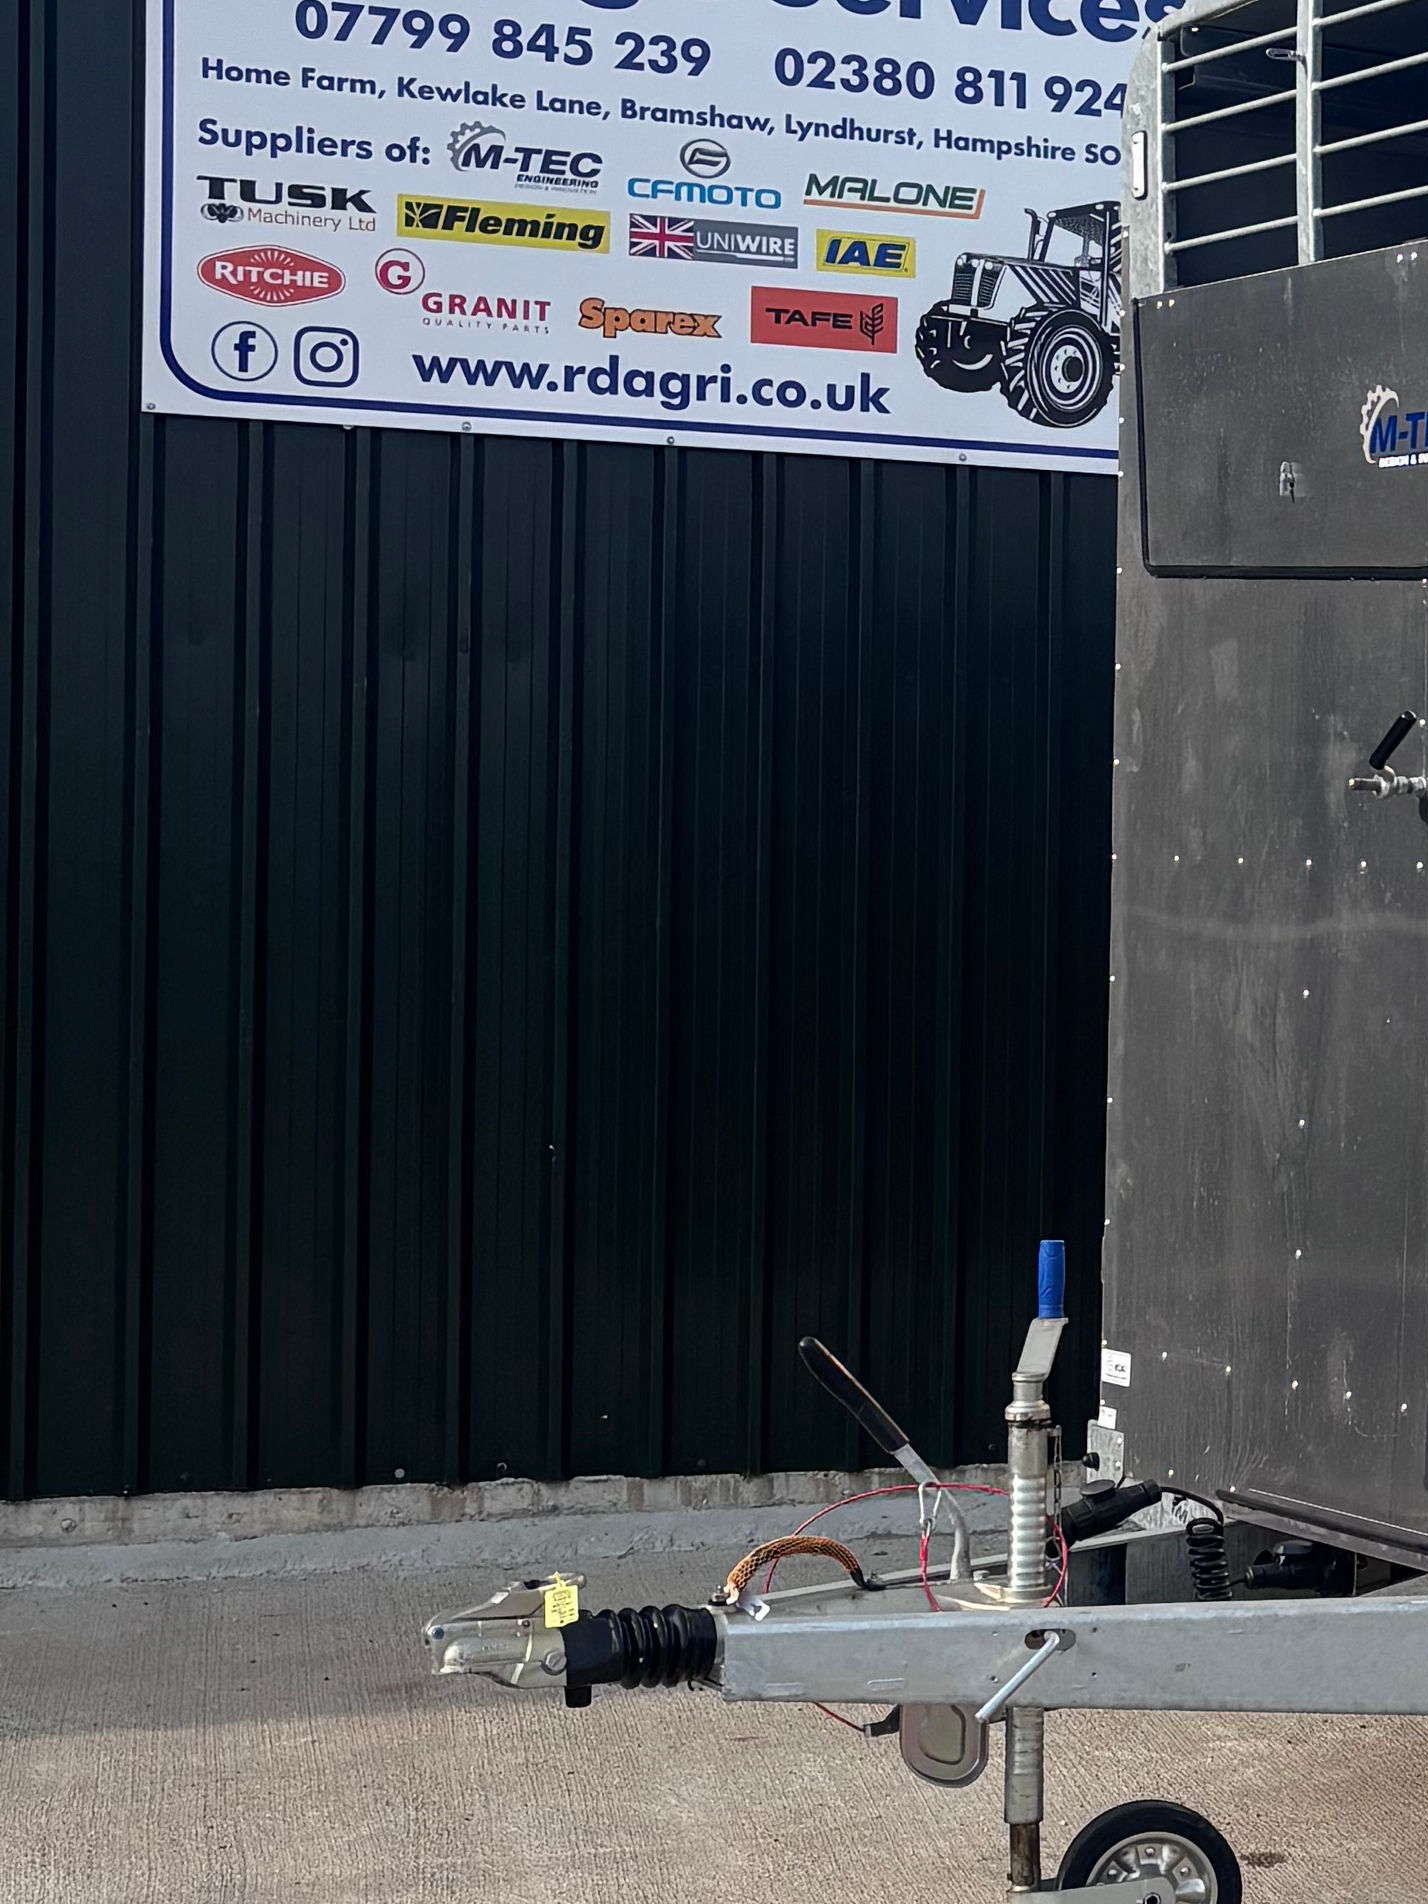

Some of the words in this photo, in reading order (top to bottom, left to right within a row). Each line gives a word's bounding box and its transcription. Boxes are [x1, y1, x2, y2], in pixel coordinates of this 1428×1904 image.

[491, 18, 593, 67] 845
[614, 31, 712, 77] 239
[774, 47, 935, 100] 02380
[954, 65, 1027, 109] 811
[1044, 75, 1128, 118] 924
[201, 57, 290, 87] Home
[301, 66, 387, 100] Farm,
[398, 77, 526, 110] Kewlake
[536, 90, 611, 121] Lane,
[621, 97, 775, 136] Bramshaw,
[784, 113, 925, 150] Lyndhurst,
[934, 128, 1076, 163] Hampshire
[198, 118, 372, 161] Suppliers
[385, 136, 431, 165] of:
[461, 143, 603, 178] M-TEC
[197, 175, 378, 214] TUSK
[516, 173, 599, 189] ENGINEERING
[627, 177, 782, 209] CFMOTO
[805, 173, 977, 210] MALONE
[247, 207, 341, 232] Machinery
[349, 214, 376, 232] Ltd
[443, 205, 605, 249] Fleming
[697, 228, 795, 256] UNIWIRE
[825, 238, 907, 269] IAE
[214, 260, 330, 289] RITCHIE
[421, 292, 552, 322] GRANIT
[578, 297, 723, 339] Sparex
[765, 307, 853, 330] TAFE
[422, 317, 493, 330] QUALITY
[502, 322, 550, 335] PARTS
[411, 353, 892, 415] www.rdagri.co.uk
